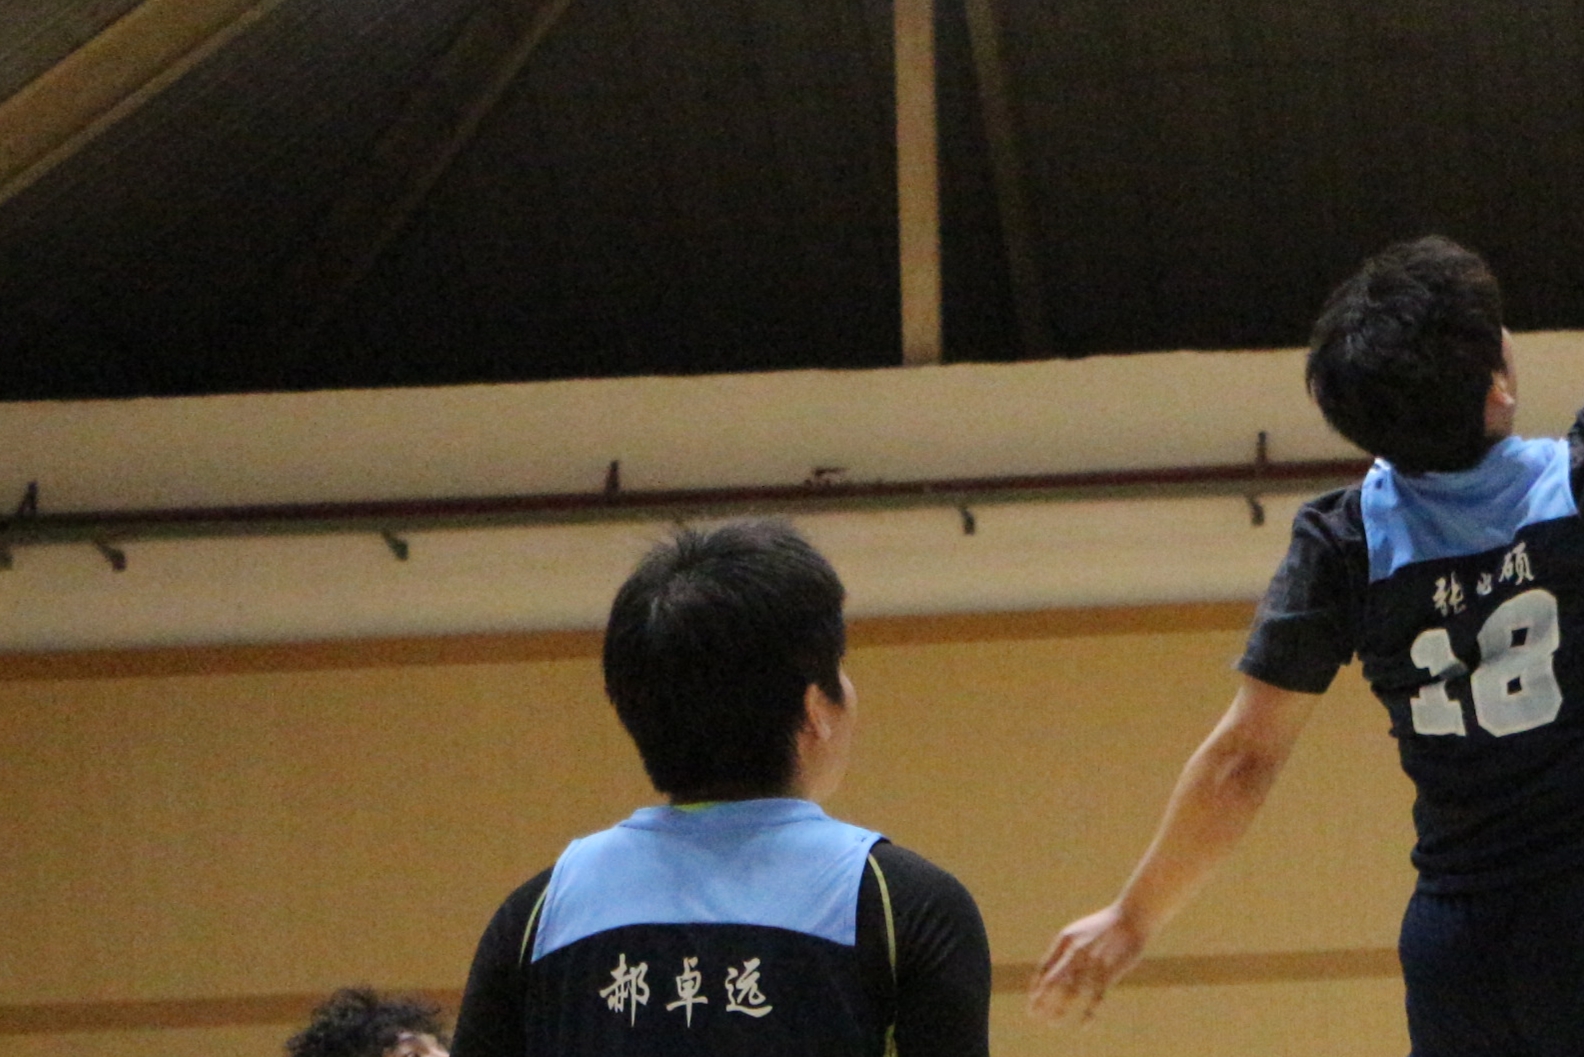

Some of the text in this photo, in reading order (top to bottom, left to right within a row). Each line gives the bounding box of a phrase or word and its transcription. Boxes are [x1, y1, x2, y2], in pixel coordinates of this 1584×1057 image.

[1410, 588, 1563, 737] 18
[600, 953, 773, 1028] 郝卓远
